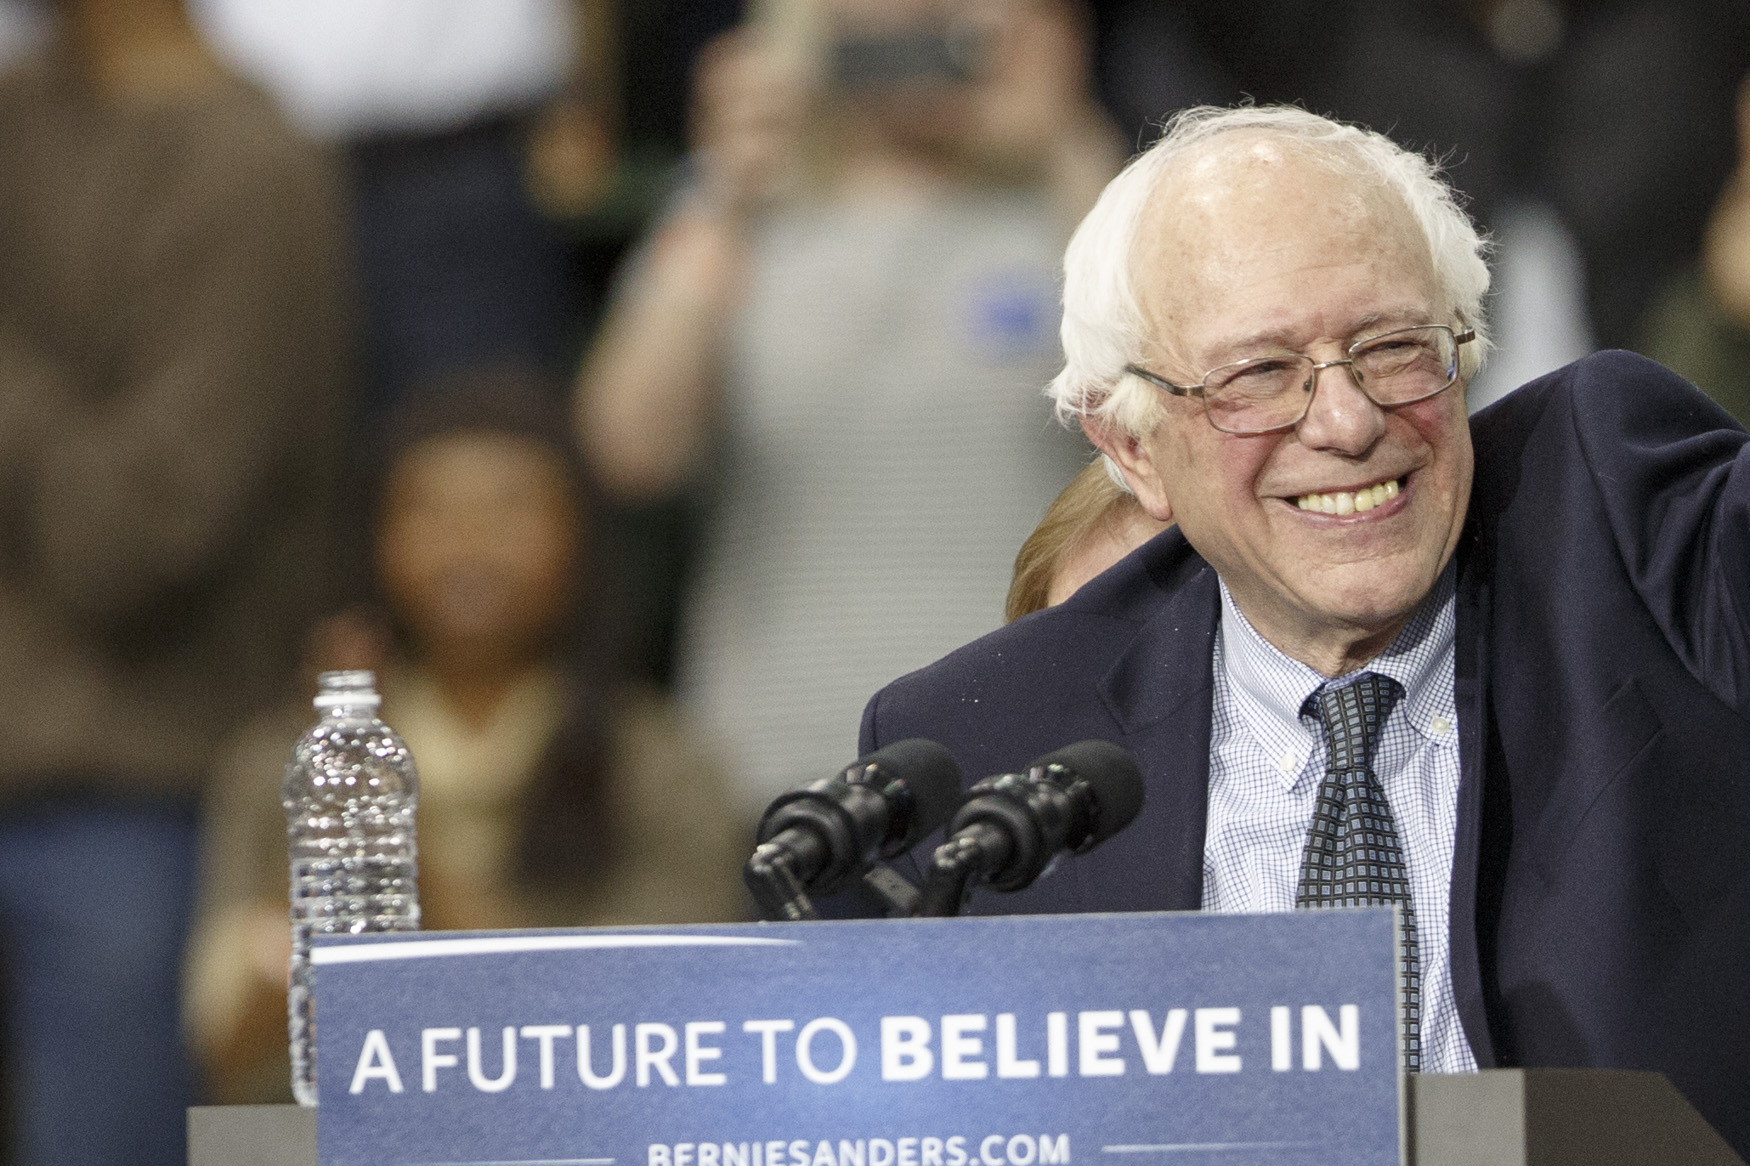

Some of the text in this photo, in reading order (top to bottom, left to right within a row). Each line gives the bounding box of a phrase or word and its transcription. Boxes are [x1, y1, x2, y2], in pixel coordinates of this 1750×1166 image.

[349, 1003, 1361, 1095] A FUTURE TO BELIEVE IN
